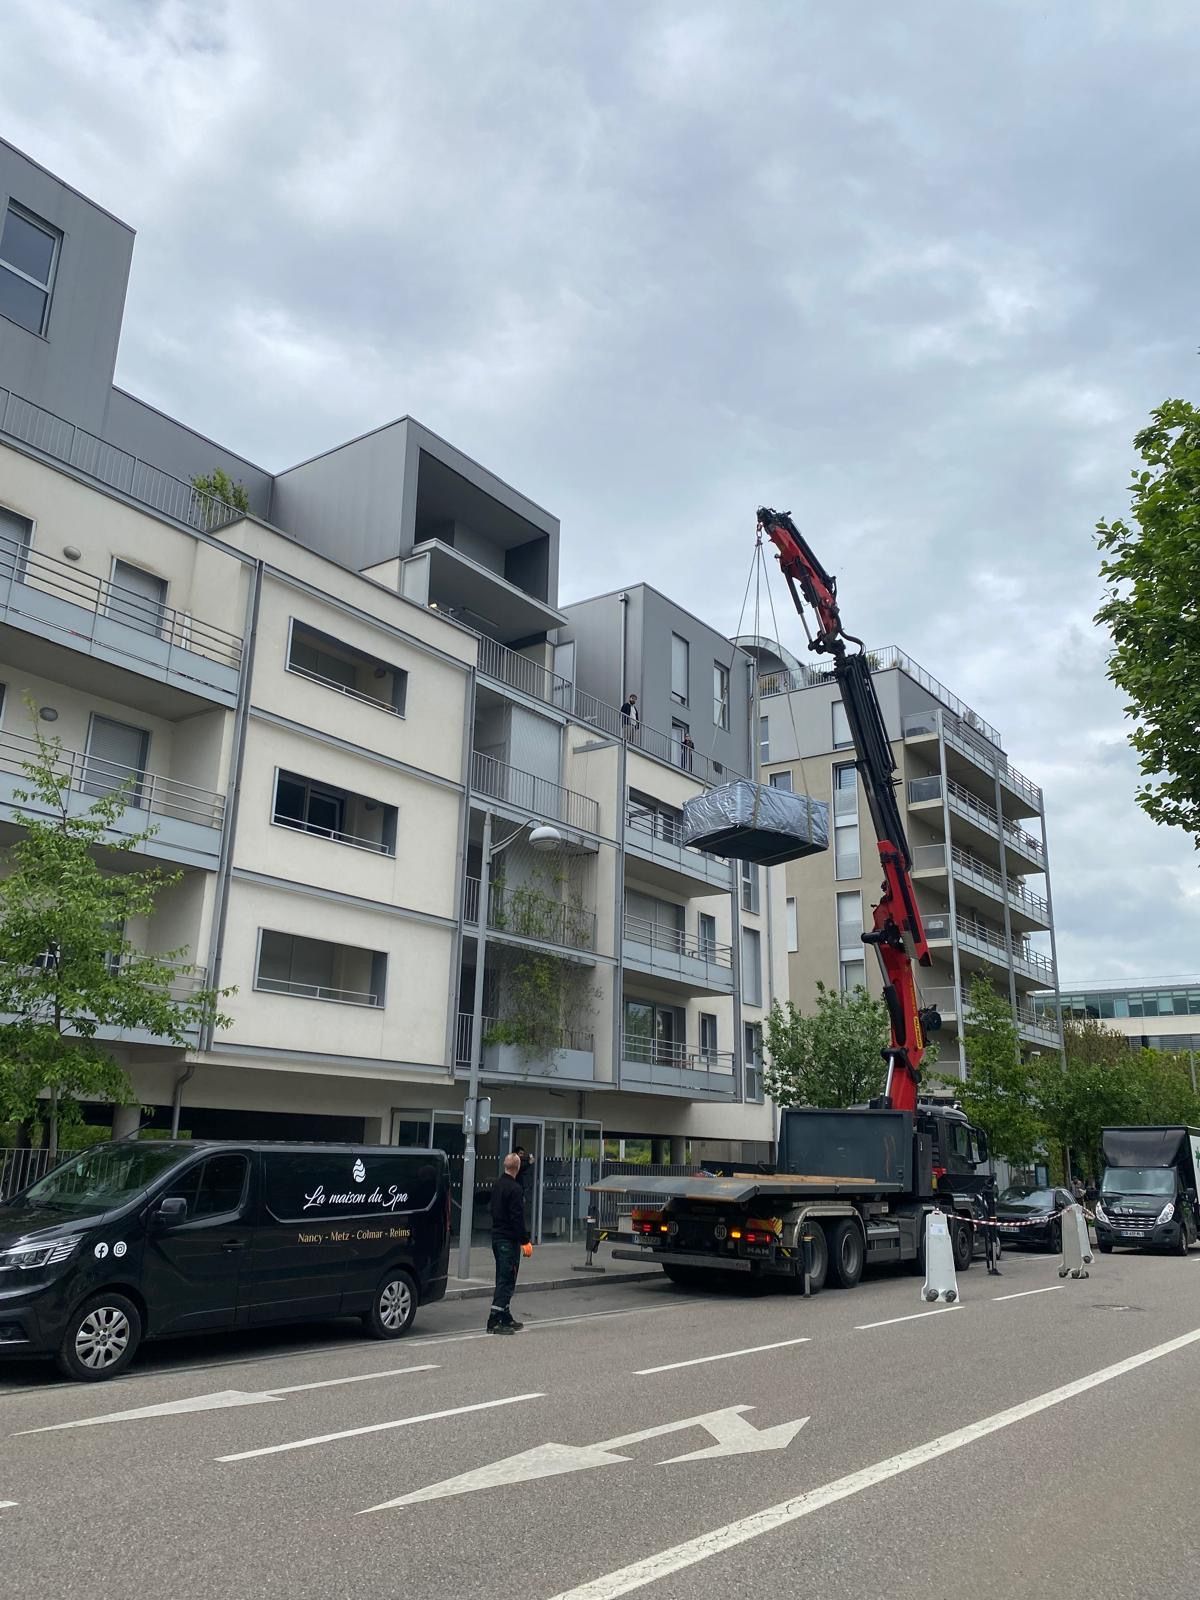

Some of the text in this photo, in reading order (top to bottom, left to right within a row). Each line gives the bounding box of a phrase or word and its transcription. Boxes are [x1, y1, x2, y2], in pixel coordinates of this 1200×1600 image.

[303, 1184, 408, 1211] La maison du Spa
[298, 1233, 323, 1244] Nancy
[331, 1232, 350, 1241] Metz
[356, 1229, 383, 1240] Colmar
[390, 1228, 411, 1238] Reims
[746, 1247, 769, 1255] MAN
